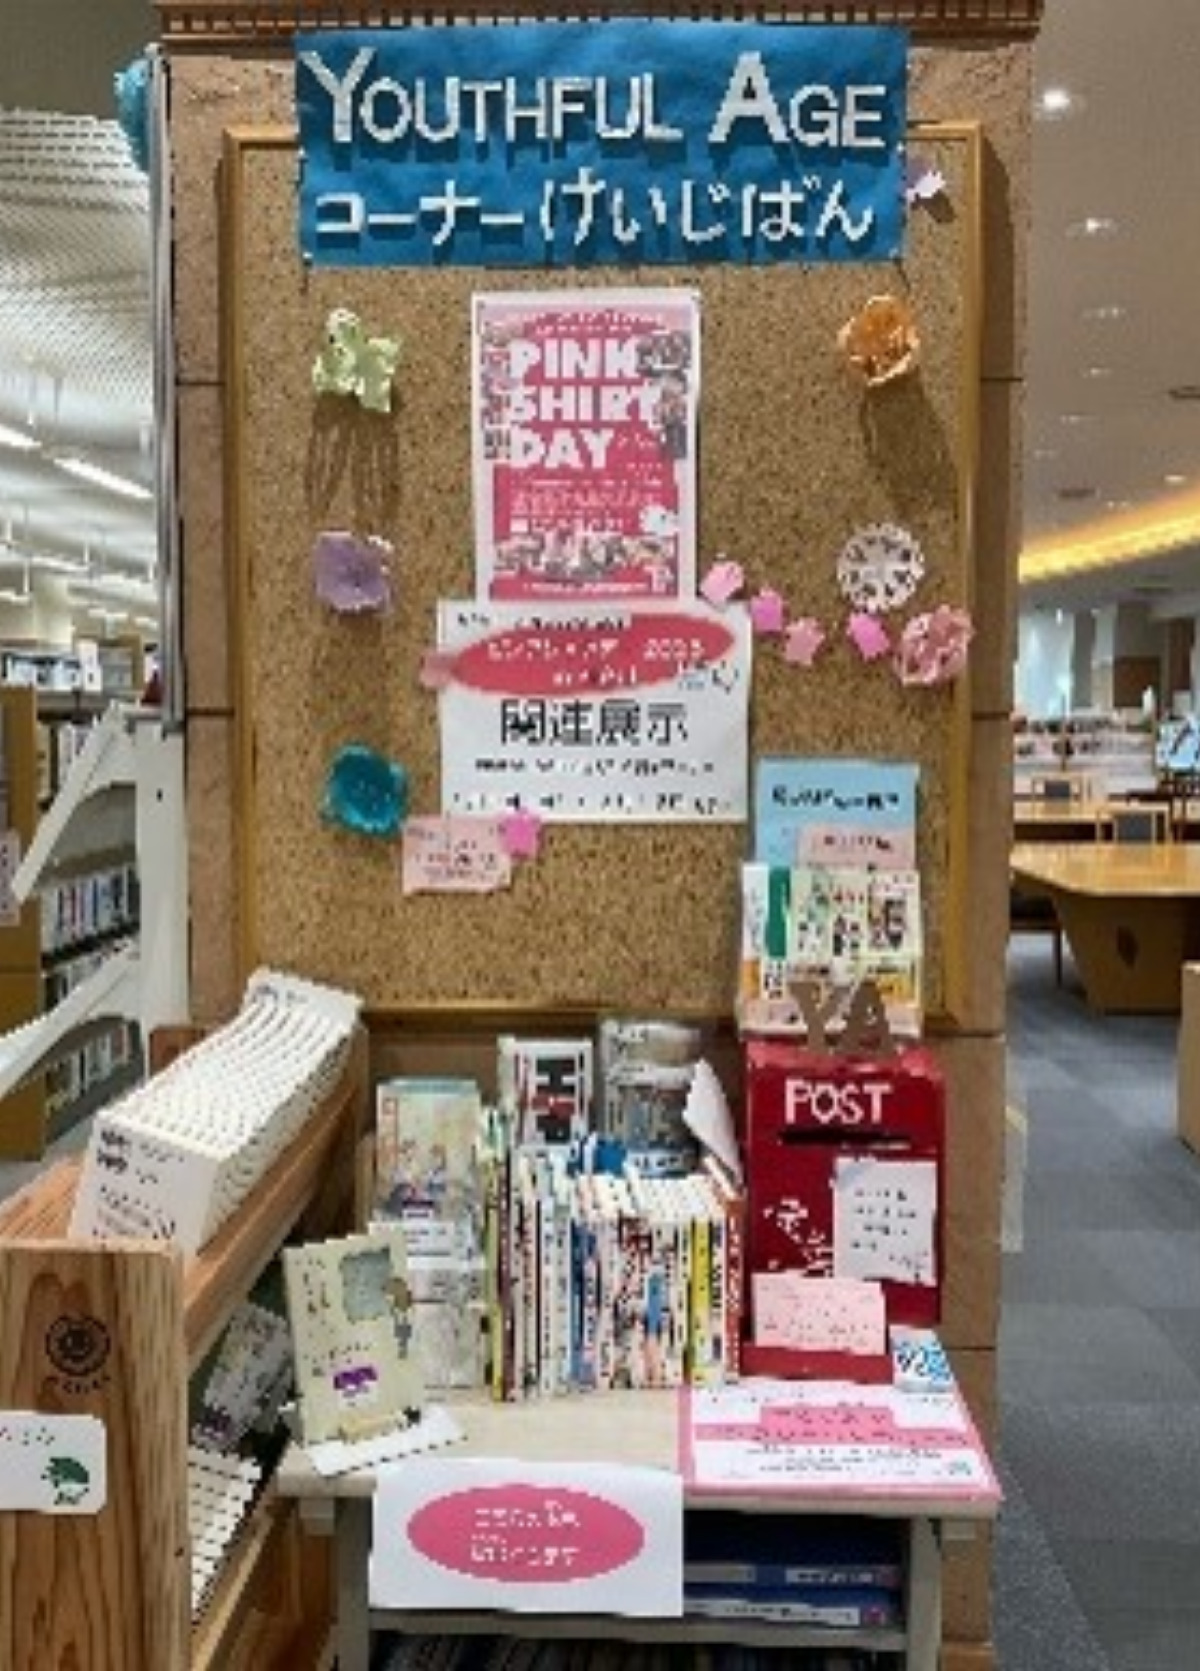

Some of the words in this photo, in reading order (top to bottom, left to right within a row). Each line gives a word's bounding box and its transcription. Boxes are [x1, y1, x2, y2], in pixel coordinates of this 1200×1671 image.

[314, 166, 875, 245] コーナーけいじばん
[509, 338, 638, 379] PINK
[509, 430, 615, 469] DAY
[501, 699, 688, 746] 関連展示
[784, 1077, 894, 1125] POST
